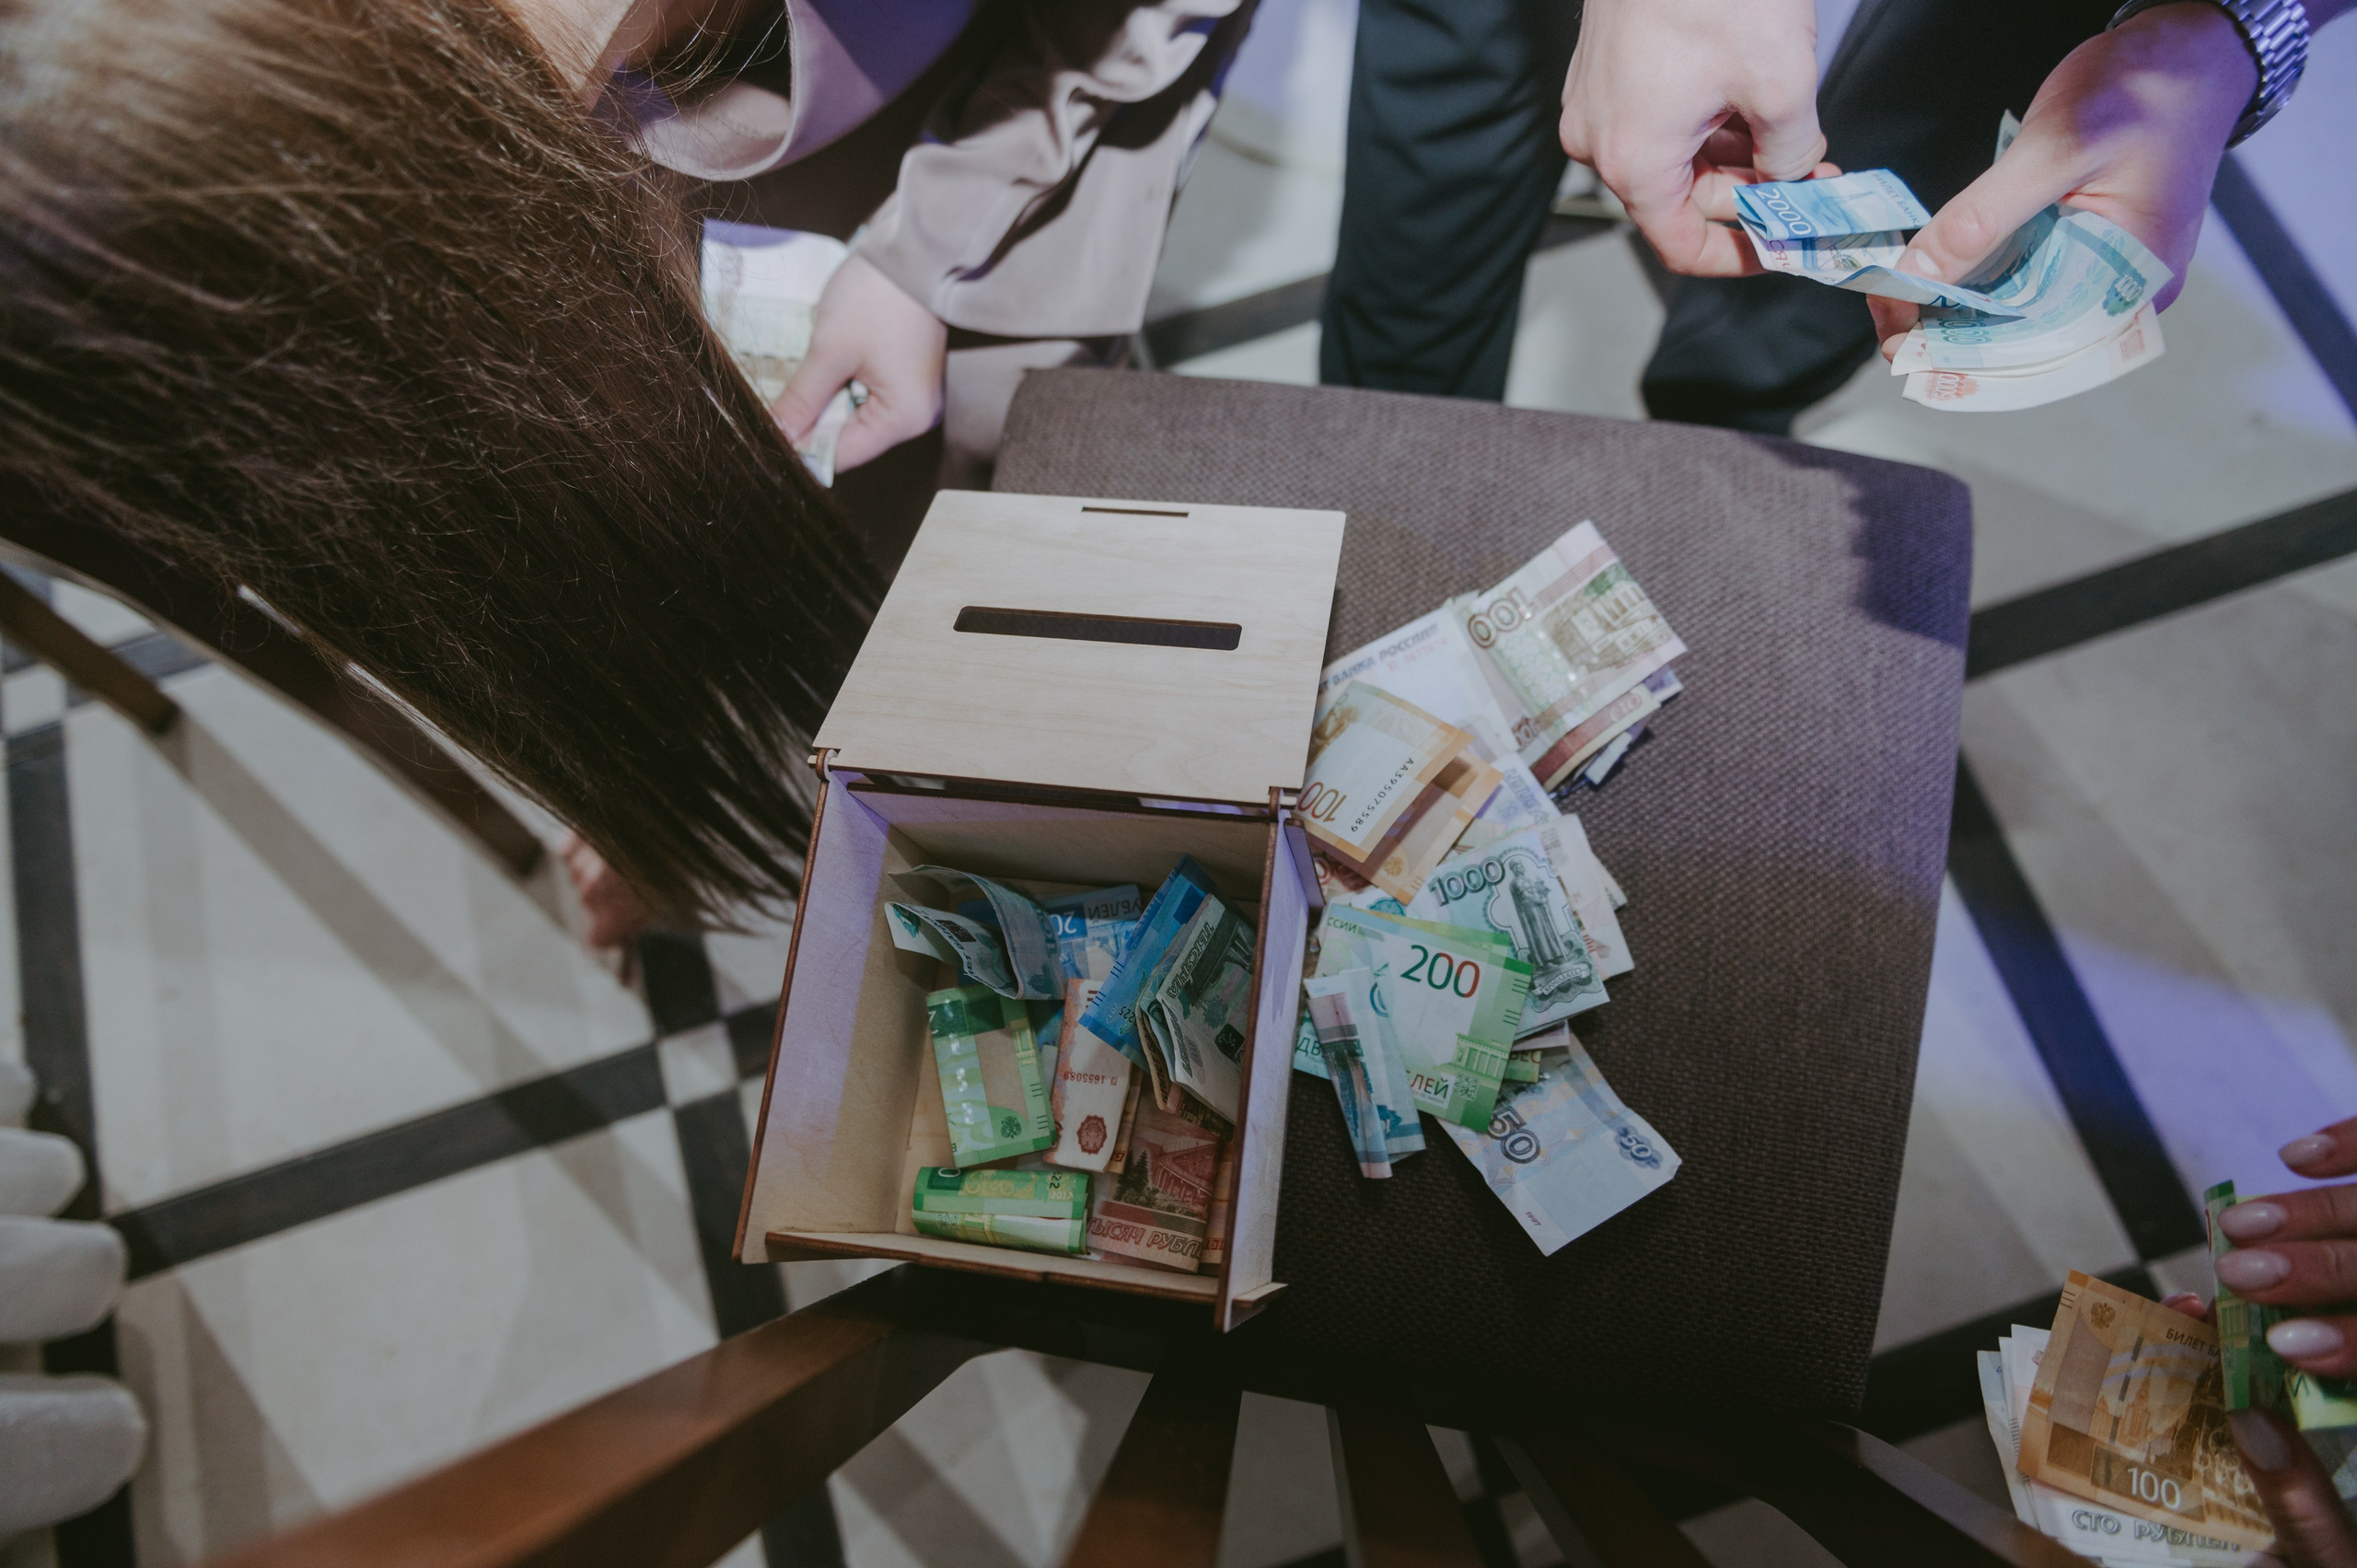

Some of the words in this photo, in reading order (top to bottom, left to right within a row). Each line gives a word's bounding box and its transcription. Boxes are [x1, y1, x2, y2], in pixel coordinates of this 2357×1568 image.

[1756, 188, 1812, 236] 2000
[2116, 274, 2143, 302] 1000
[1468, 587, 1532, 648] 100
[1297, 782, 1348, 823] 100
[1429, 856, 1505, 907] 1000
[1399, 945, 1480, 998] 200
[1063, 1071, 1106, 1085] 1655089
[1408, 1071, 1449, 1099] ЛЕЙ
[1488, 1106, 1540, 1164] 50
[1620, 1134, 1655, 1161] 50
[1525, 1211, 1541, 1226] 1997
[1146, 1230, 1202, 1258] РУБЛ
[2165, 1328, 2207, 1351] БИЛЕТ
[2127, 1467, 2181, 1510] 100
[2072, 1510, 2121, 1536] СТО
